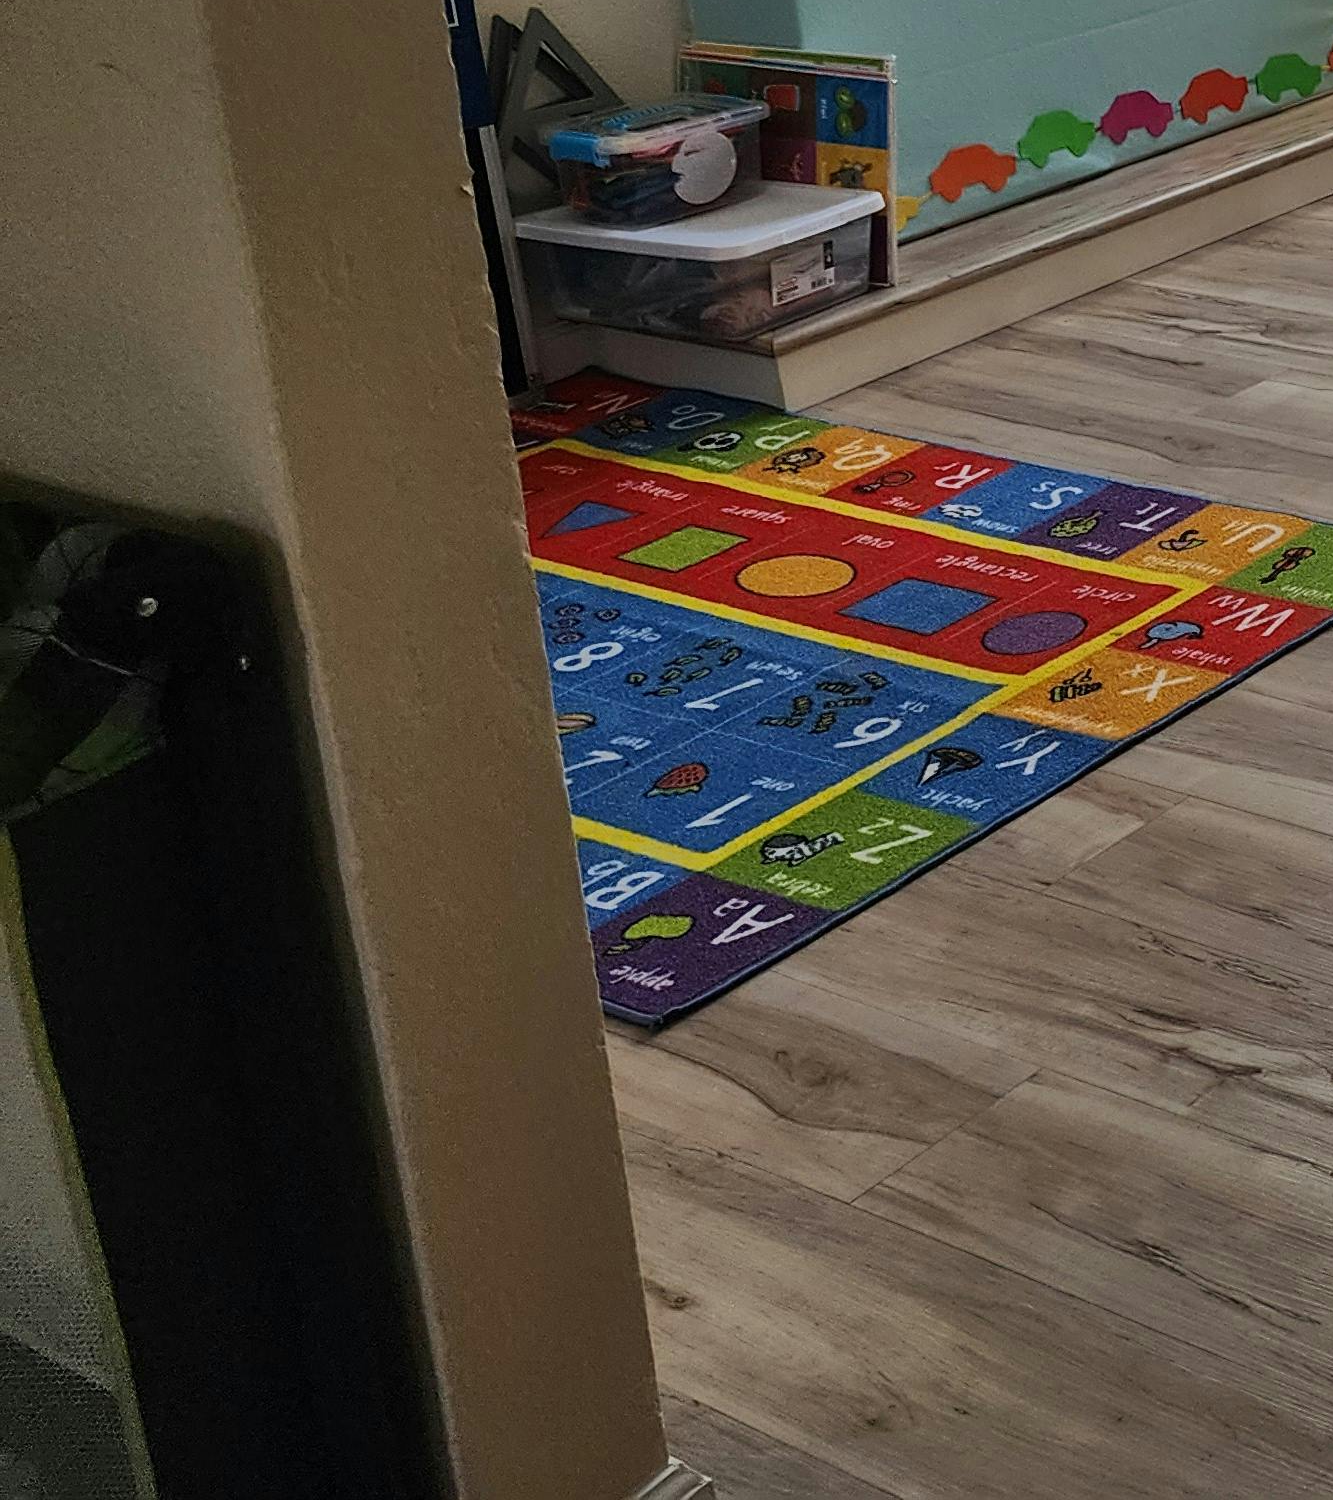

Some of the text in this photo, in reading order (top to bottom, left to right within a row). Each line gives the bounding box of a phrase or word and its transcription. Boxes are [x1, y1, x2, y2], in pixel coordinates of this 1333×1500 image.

[668, 404, 725, 430] Oo
[933, 461, 993, 490] Rr
[1029, 480, 1084, 510] Ss
[719, 505, 793, 526] square
[1120, 501, 1180, 532] Tt
[841, 533, 897, 550] oval
[1221, 520, 1286, 553] Uu
[935, 552, 1040, 583] rectangle
[1071, 583, 1138, 605] circle
[1280, 583, 1333, 601] violin
[1208, 593, 1296, 637] Ww
[552, 639, 625, 673] 8
[1170, 646, 1235, 666] whale
[1118, 662, 1198, 703] Xx
[994, 728, 1061, 776] Yy
[919, 786, 995, 814] yacht
[849, 818, 934, 865] Zz
[582, 859, 666, 911] Bb
[709, 897, 795, 946] Aa
[608, 965, 676, 991] apple
